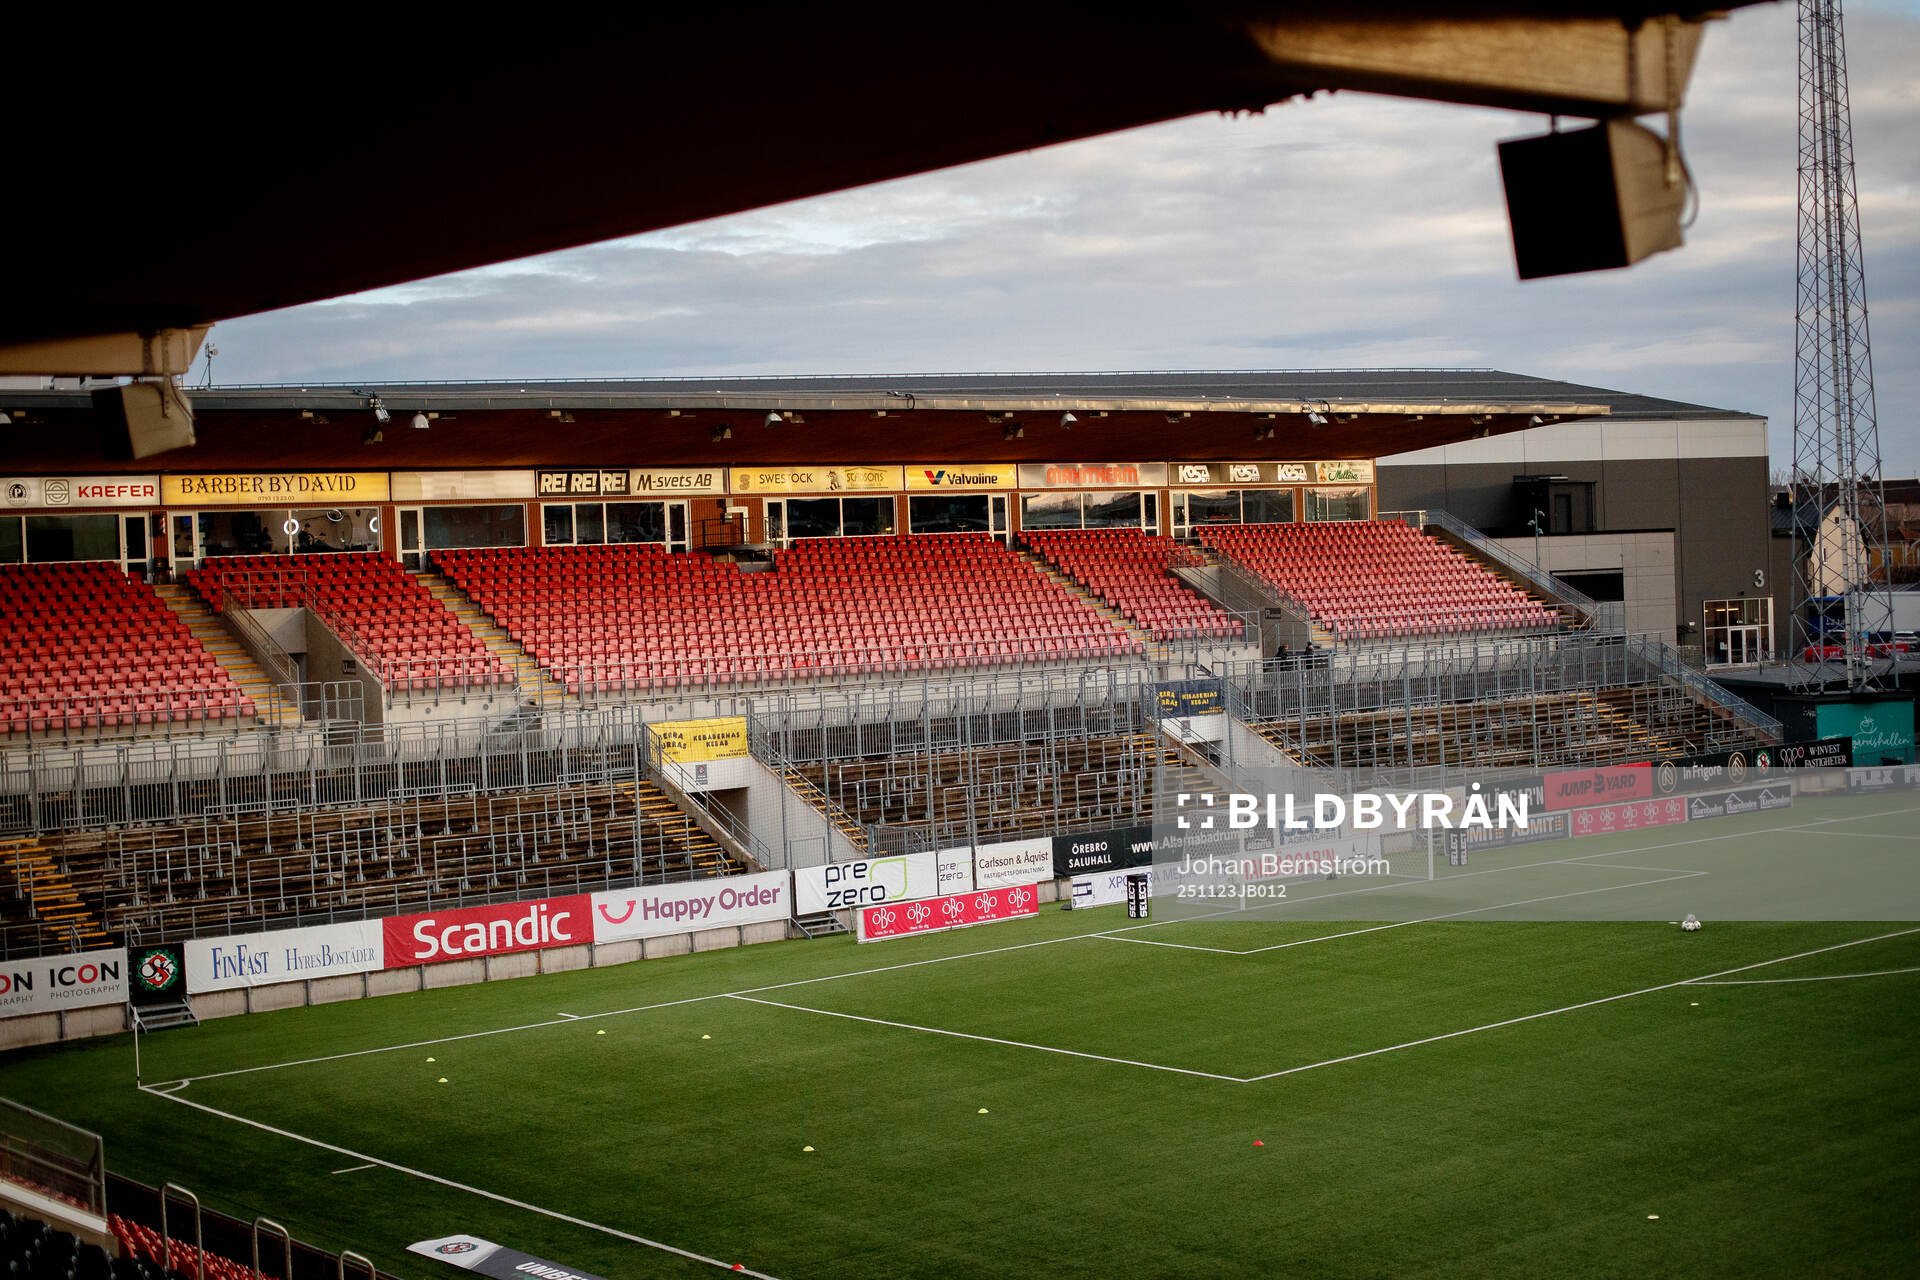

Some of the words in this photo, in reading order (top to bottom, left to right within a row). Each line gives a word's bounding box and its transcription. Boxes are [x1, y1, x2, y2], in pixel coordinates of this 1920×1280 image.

[181, 476, 264, 494] BARBER
[269, 475, 295, 493] BY
[298, 475, 356, 492] DAVID
[540, 473, 568, 493] RE!
[571, 473, 598, 492] RE!
[602, 472, 626, 492] RE!
[637, 474, 692, 491] M-svets
[694, 473, 713, 487] AB
[759, 472, 813, 484] SWESOCK
[78, 485, 155, 498] KAEFER
[1753, 569, 1766, 588] 3
[1692, 763, 1723, 781] Frigore
[1850, 769, 1894, 787] FLEX
[1556, 780, 1593, 798] JUMP
[1606, 774, 1637, 791] YARD
[1071, 841, 1108, 855] ÖREBRO
[1450, 833, 1458, 866] SELECT
[939, 861, 957, 874] pre
[978, 855, 1014, 870] Carlsson
[1015, 855, 1022, 865] &
[1023, 850, 1049, 866] Åqvist
[1068, 854, 1112, 869] SALUHALL
[825, 862, 868, 888] pre
[939, 871, 963, 882] zero
[1108, 871, 1161, 889] XPORA
[642, 896, 716, 922] Happy
[718, 884, 781, 910] Order
[826, 885, 886, 908] zero
[975, 892, 998, 914] ÖBO
[1008, 887, 1031, 909] ÖBO
[1129, 881, 1137, 918] SELECT
[1138, 881, 1148, 918] SELECT
[872, 907, 896, 929] ÖBO
[907, 903, 931, 924] ÖBO
[942, 897, 965, 919] ÖBO
[413, 903, 572, 959] Scandic
[50, 961, 120, 988] ICON
[0, 994, 34, 1006] RAPHY
[50, 983, 121, 1000] PHOTOGRAPHY
[515, 1262, 589, 1280] UNIBE
